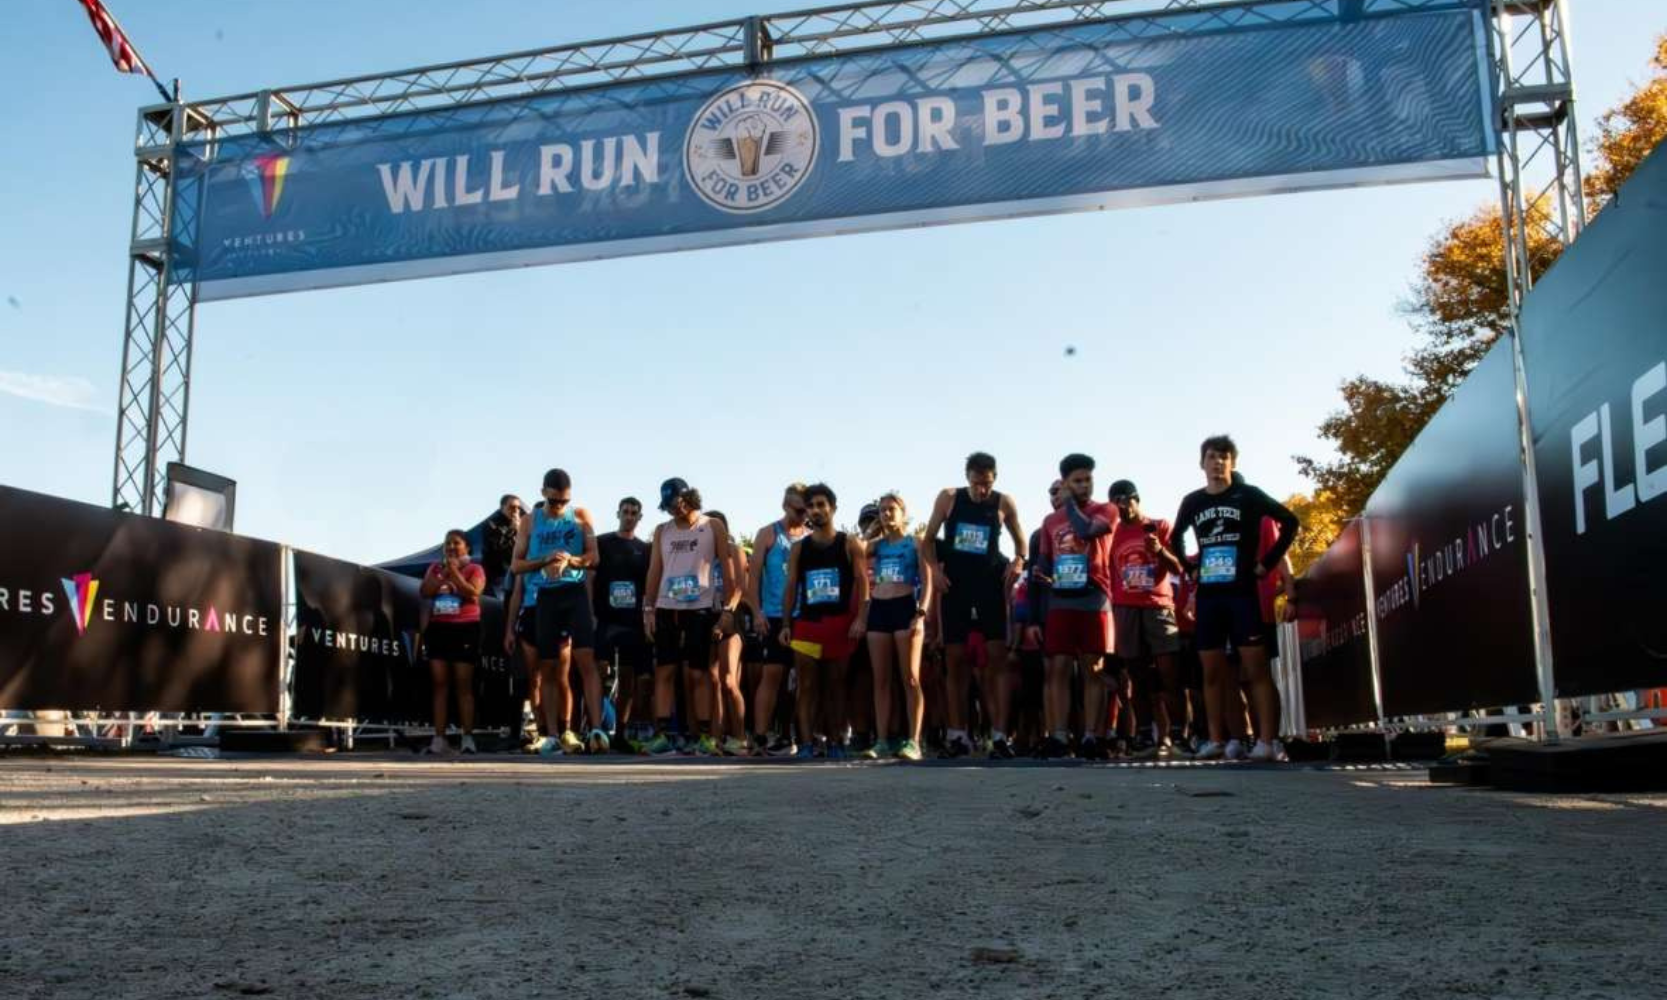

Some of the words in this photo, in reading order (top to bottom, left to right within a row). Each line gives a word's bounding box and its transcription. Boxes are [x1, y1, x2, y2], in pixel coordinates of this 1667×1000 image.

[700, 91, 748, 131] WILL
[757, 91, 799, 122] RUN
[837, 96, 960, 162] FOR
[980, 72, 1162, 146] BEER
[376, 150, 520, 214] WILL
[536, 131, 661, 196] RUN
[701, 169, 739, 202] FOR
[745, 163, 799, 202] BEER
[223, 229, 306, 248] VENTURES
[1194, 506, 1216, 526] LANE
[1217, 505, 1240, 521] TECH
[1420, 504, 1515, 591] ENDURANCE
[103, 599, 269, 635] ENDURANCE
[312, 627, 399, 657] VENTURES
